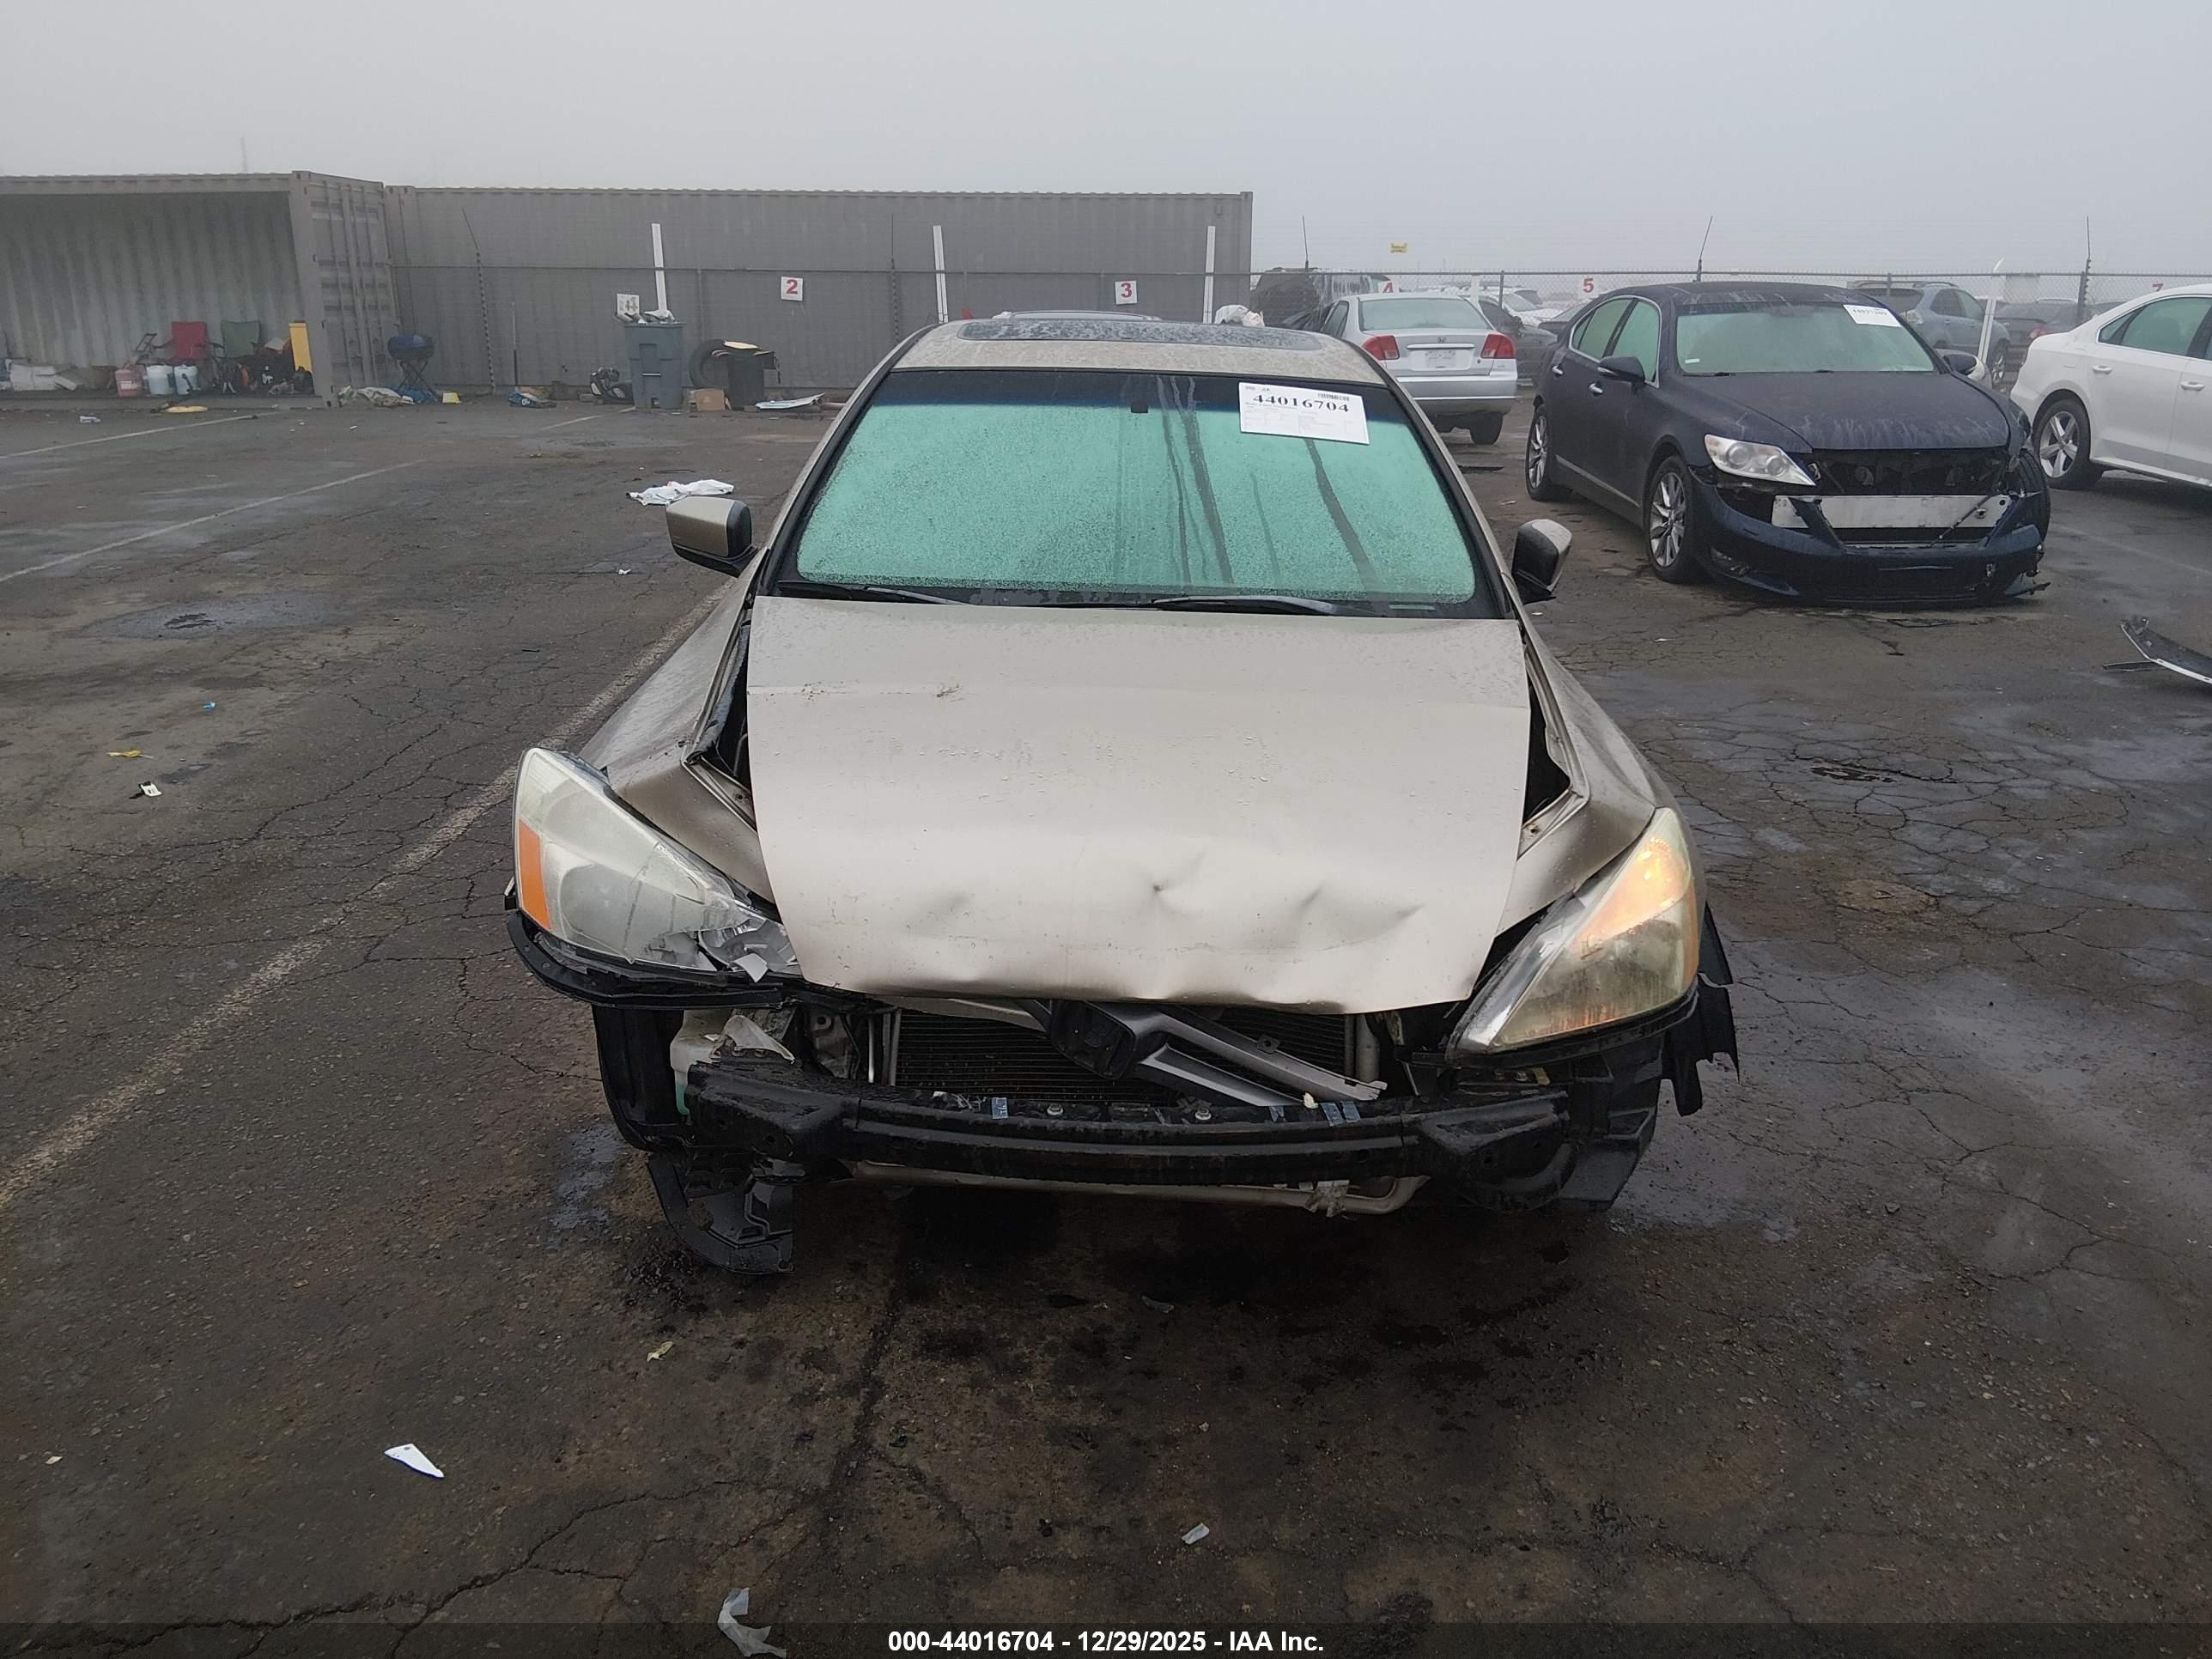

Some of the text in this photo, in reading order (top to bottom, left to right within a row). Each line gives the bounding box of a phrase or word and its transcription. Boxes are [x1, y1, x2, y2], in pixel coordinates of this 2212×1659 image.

[786, 279, 798, 295] 2
[1121, 283, 1132, 298] 3
[1583, 278, 1595, 293] 5
[1252, 393, 1350, 413] 44016704
